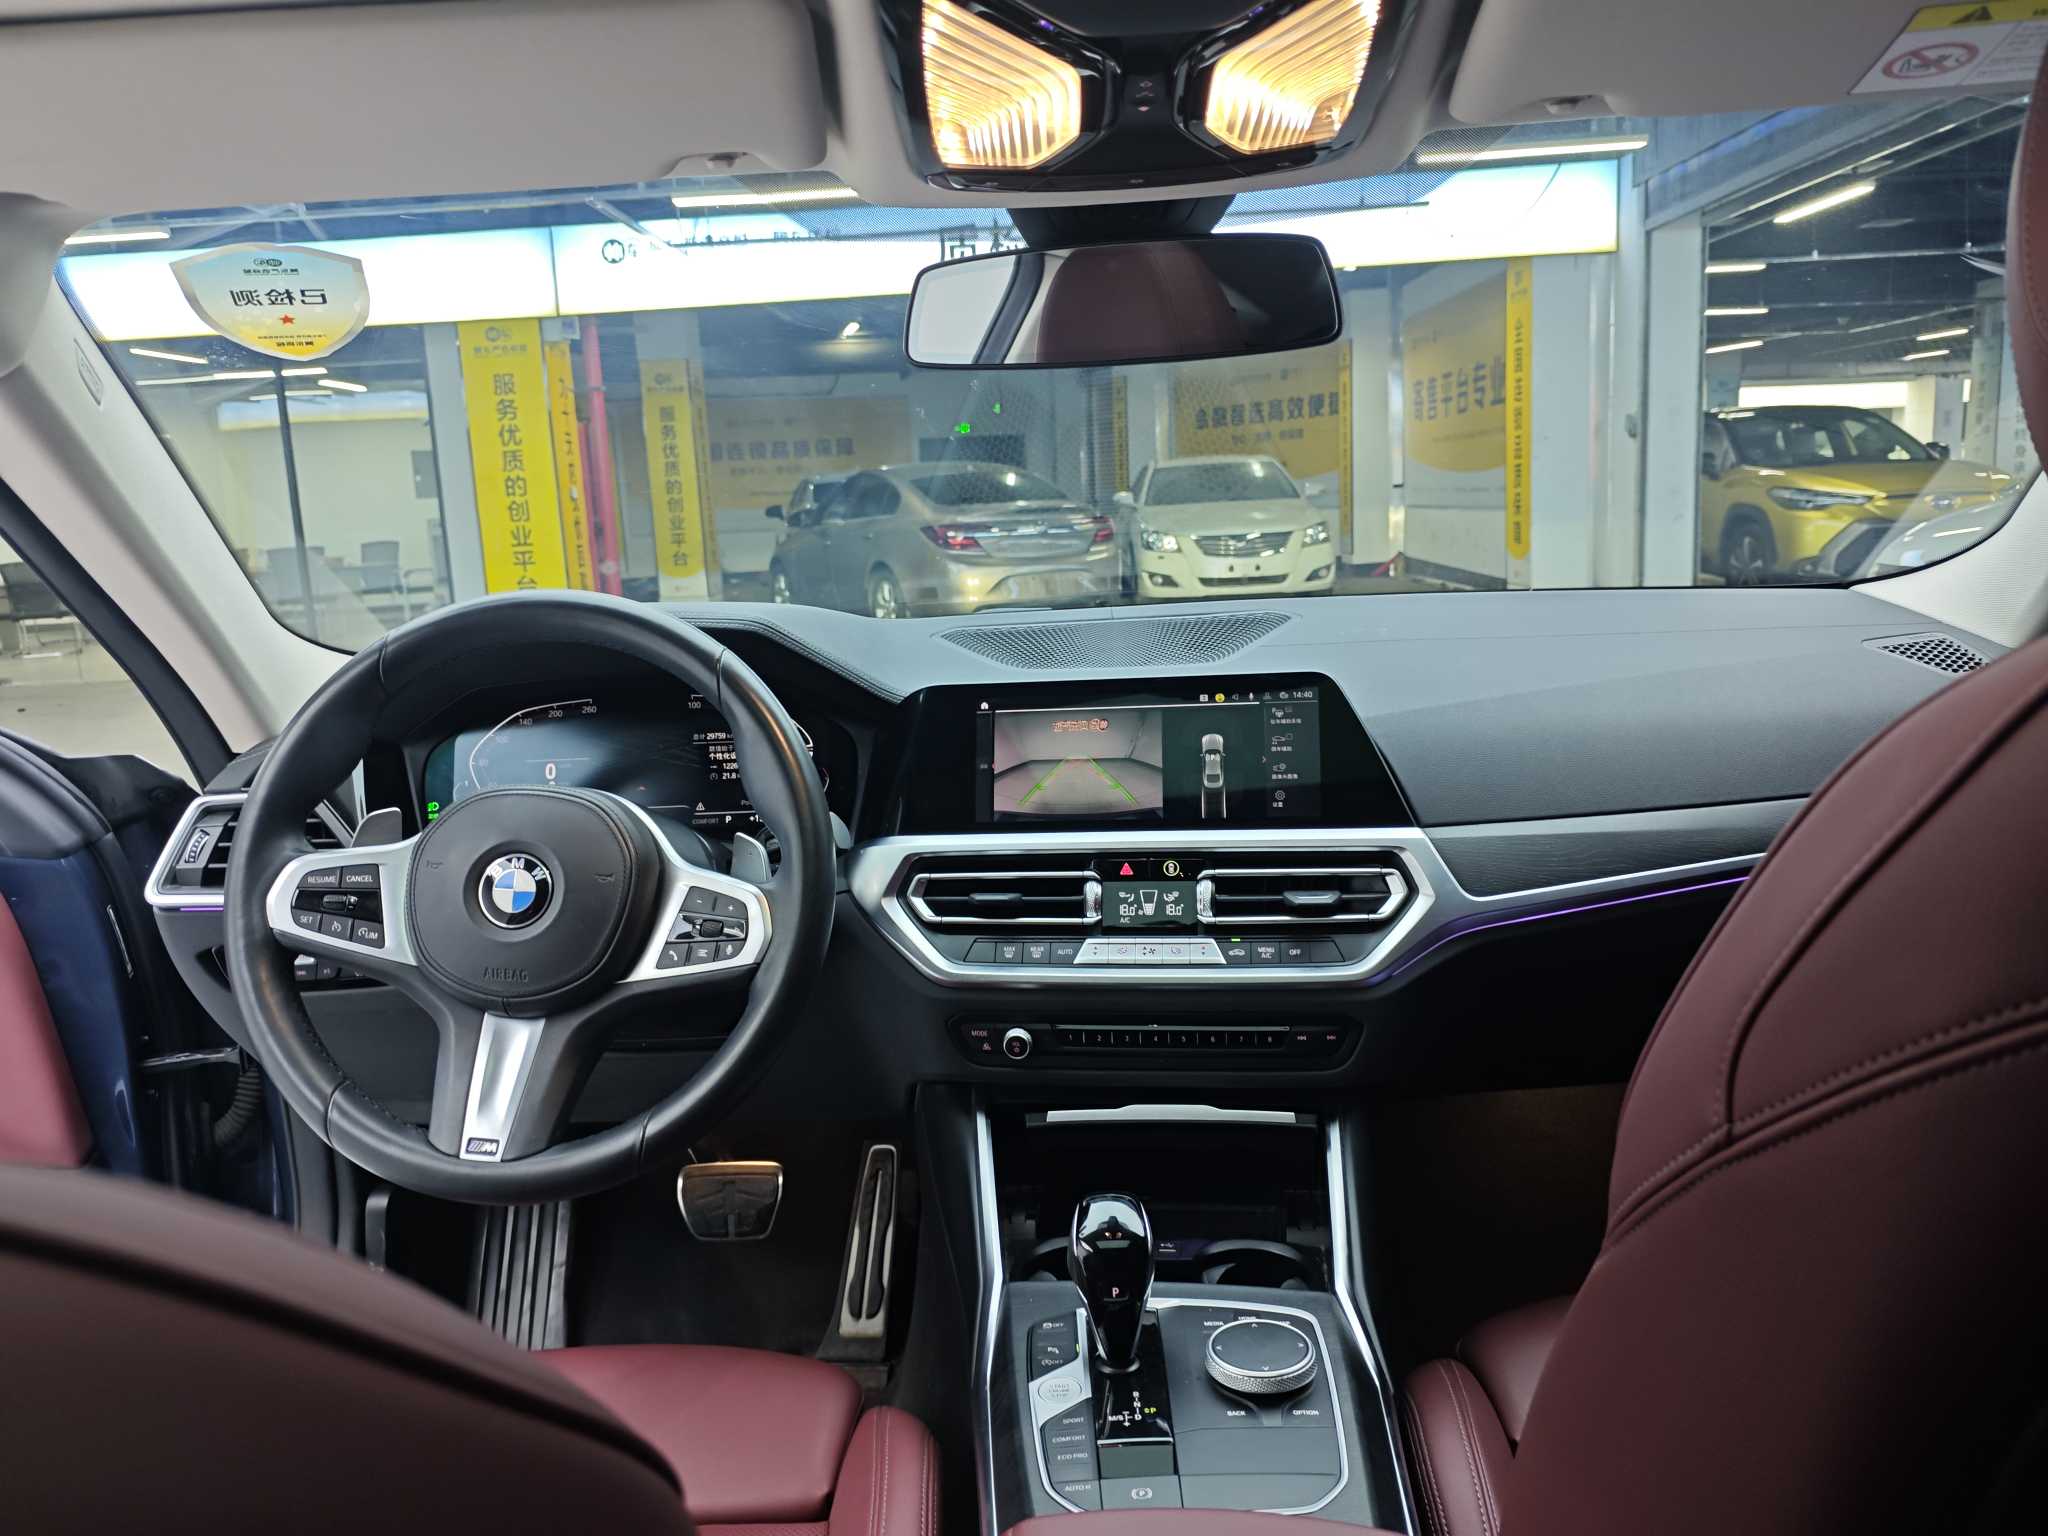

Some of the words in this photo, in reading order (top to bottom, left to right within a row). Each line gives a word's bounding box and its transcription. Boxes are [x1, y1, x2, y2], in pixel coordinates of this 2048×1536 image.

[492, 372, 538, 590] 服务优质的创业平台
[659, 405, 689, 567] 服务优质的创业平台
[1292, 690, 1313, 699] 14:40
[581, 704, 597, 714] 260
[687, 701, 702, 709] 100
[548, 709, 563, 718] 200
[518, 717, 533, 726] 140
[545, 762, 557, 780] 0
[725, 815, 732, 824] P
[487, 856, 548, 882] BMW
[307, 874, 338, 884] RESUME
[346, 874, 374, 883] CANCEL
[300, 915, 313, 923] SET
[364, 931, 379, 940] LIM
[1057, 948, 1073, 956] AUTO
[1289, 948, 1301, 956] OFF
[482, 966, 529, 982] AIRBAG
[971, 1030, 988, 1038] MODE
[1111, 1287, 1120, 1298] P
[1062, 1416, 1085, 1424] SPORT
[1052, 1434, 1086, 1443] COMFORT
[1057, 1453, 1073, 1461] ECO
[1064, 1484, 1085, 1492] AUTO
